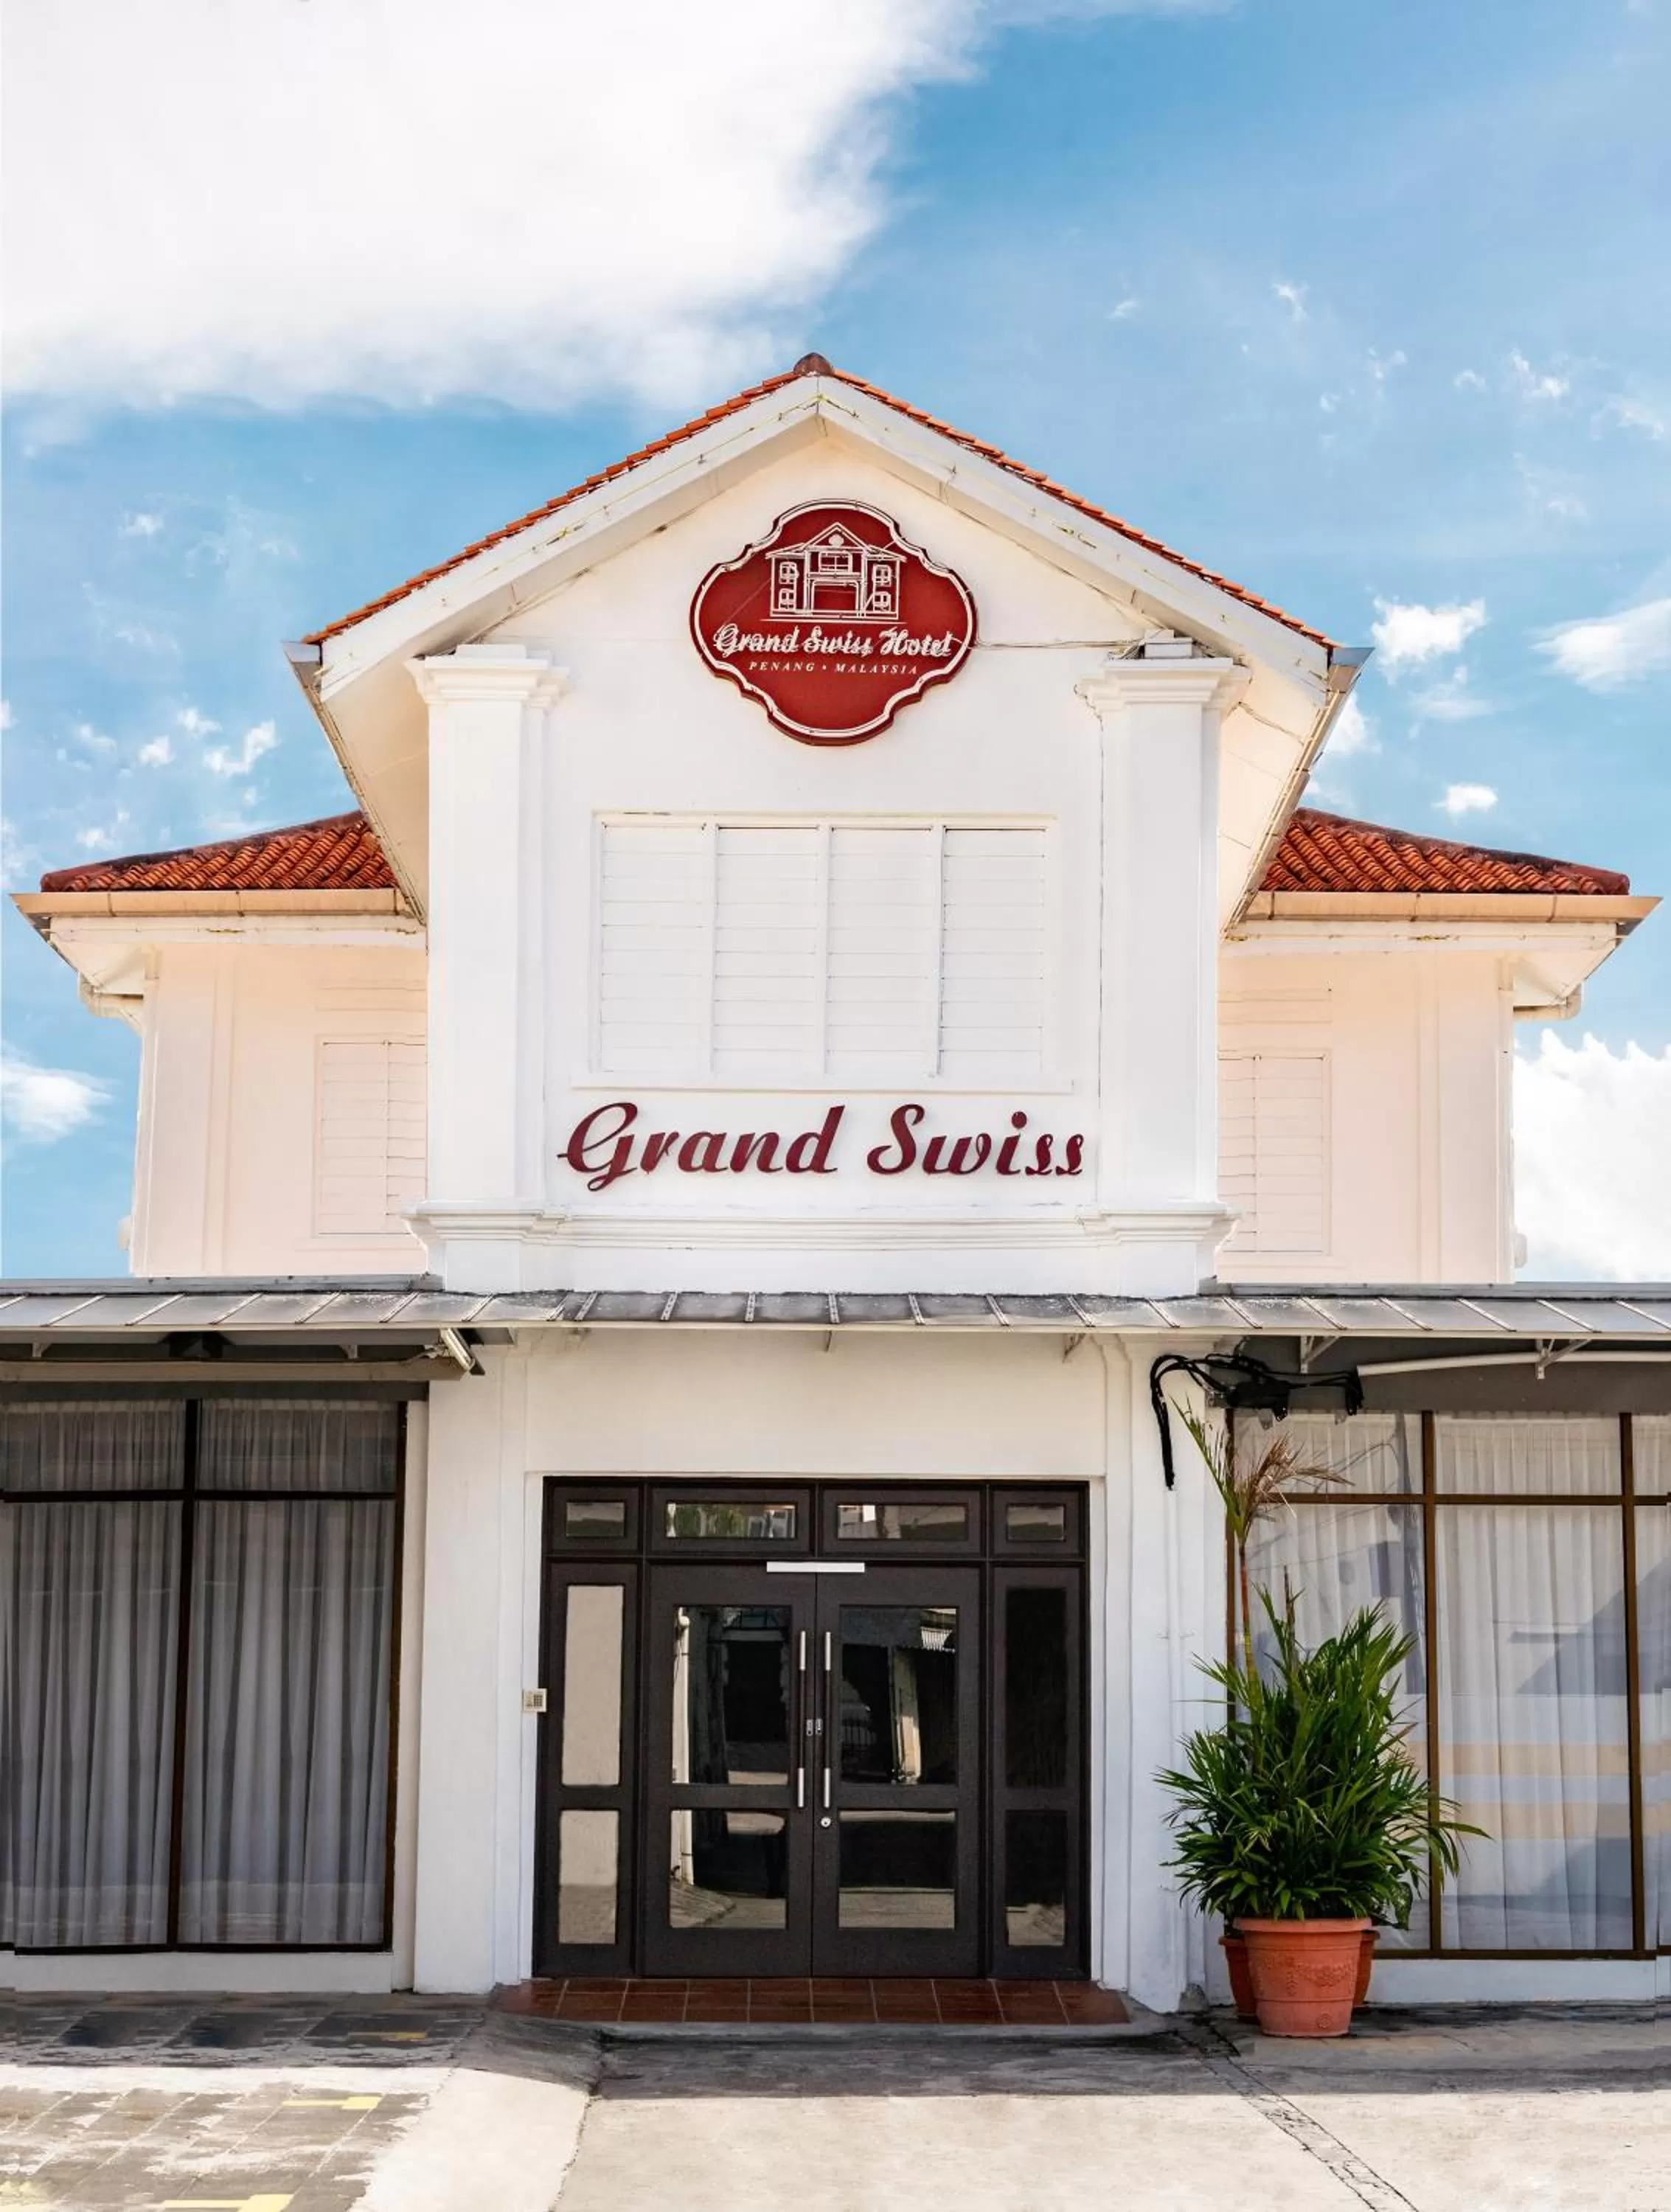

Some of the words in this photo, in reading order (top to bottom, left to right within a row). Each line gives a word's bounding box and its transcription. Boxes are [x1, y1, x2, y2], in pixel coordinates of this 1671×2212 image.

[713, 623, 799, 657] Grand
[804, 625, 873, 658] Swiss
[879, 626, 953, 657] Hotel
[748, 661, 815, 672] PENANG
[834, 664, 918, 675] MALAYSIA
[557, 1102, 846, 1192] Grand
[866, 1103, 1084, 1177] Swiss
